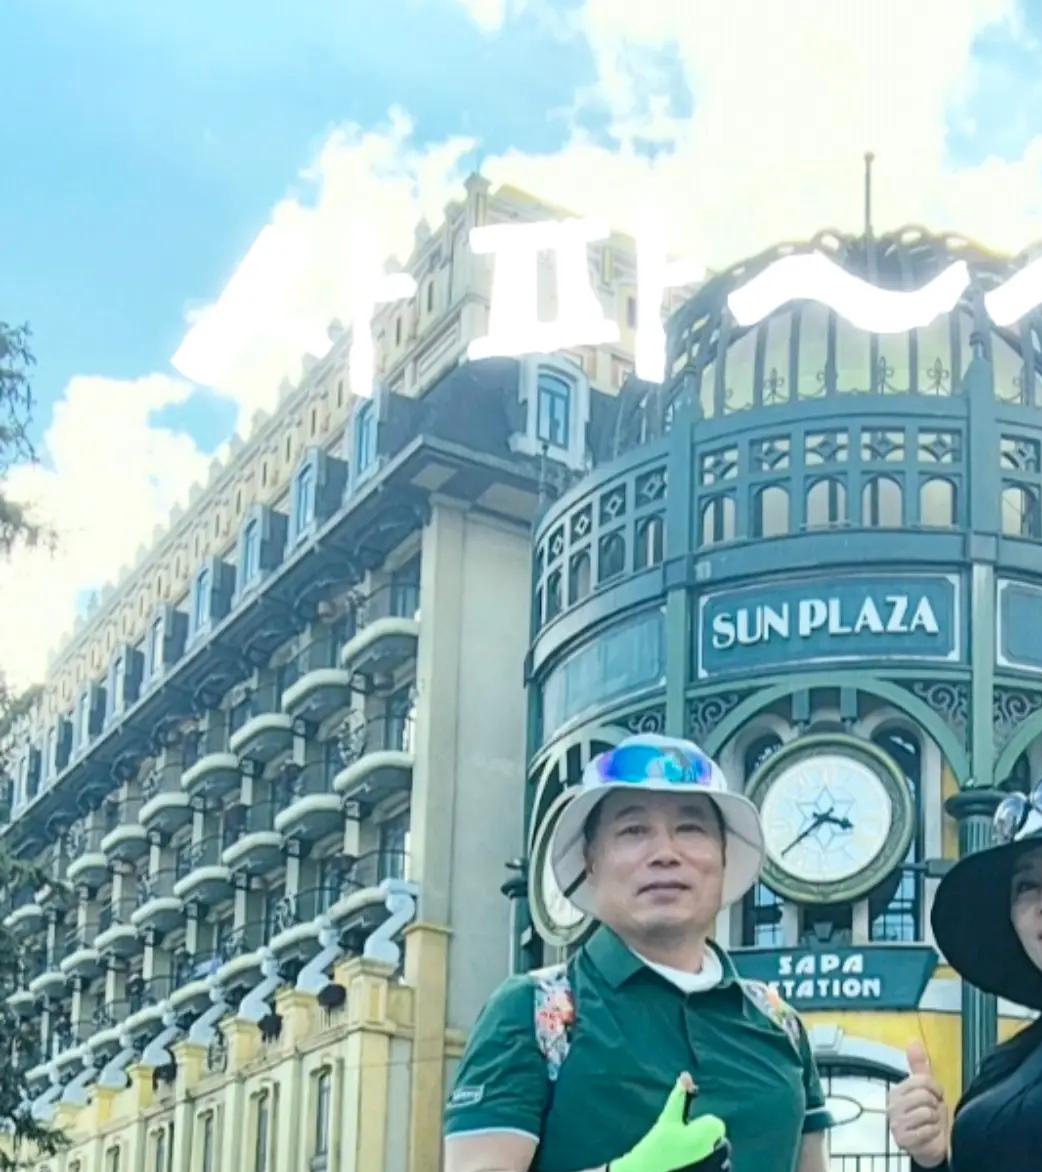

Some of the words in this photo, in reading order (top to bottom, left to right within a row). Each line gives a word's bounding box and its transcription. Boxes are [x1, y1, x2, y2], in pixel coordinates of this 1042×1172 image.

[712, 603, 790, 649] SUN
[798, 596, 940, 638] PLAZA
[778, 953, 865, 976] SAPA
